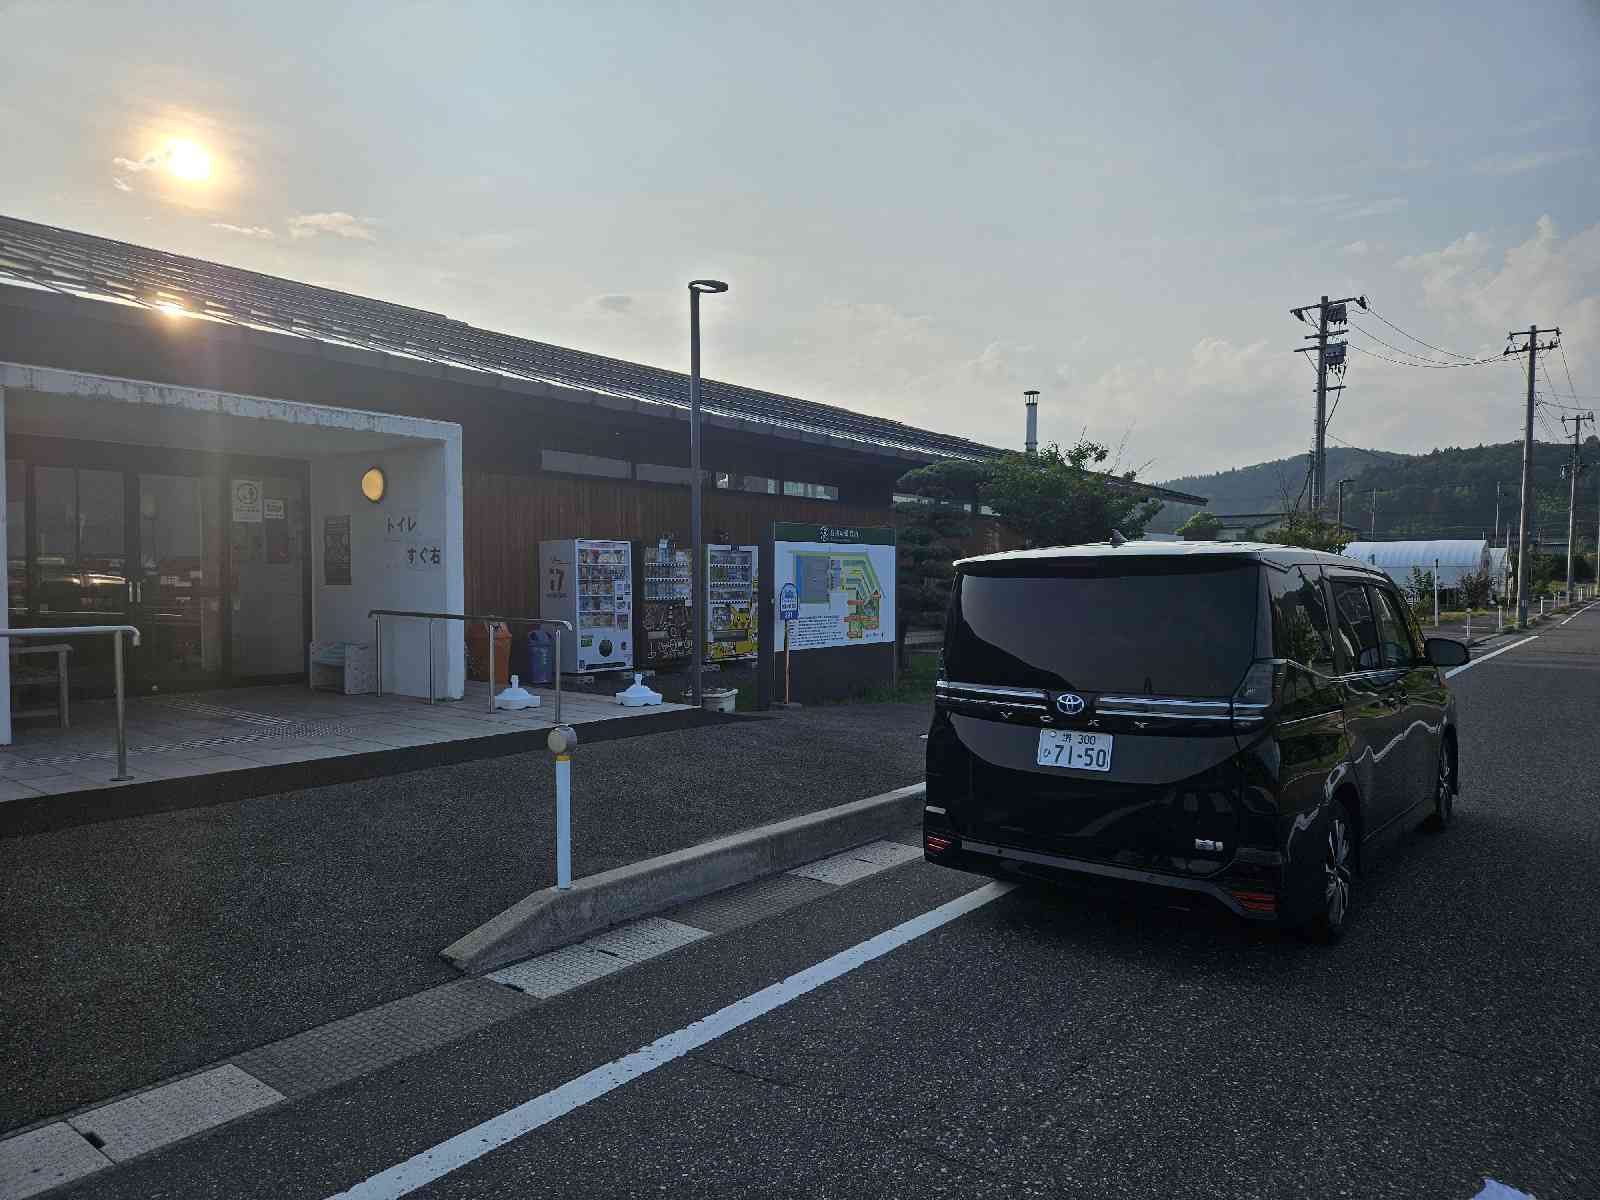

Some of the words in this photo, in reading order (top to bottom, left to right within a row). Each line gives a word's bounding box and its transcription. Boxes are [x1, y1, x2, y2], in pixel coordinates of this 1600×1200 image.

[387, 516, 417, 533] トイレ
[407, 547, 441, 564] すぐ右
[1078, 734, 1097, 746] 300
[1055, 744, 1107, 768] 71-50
